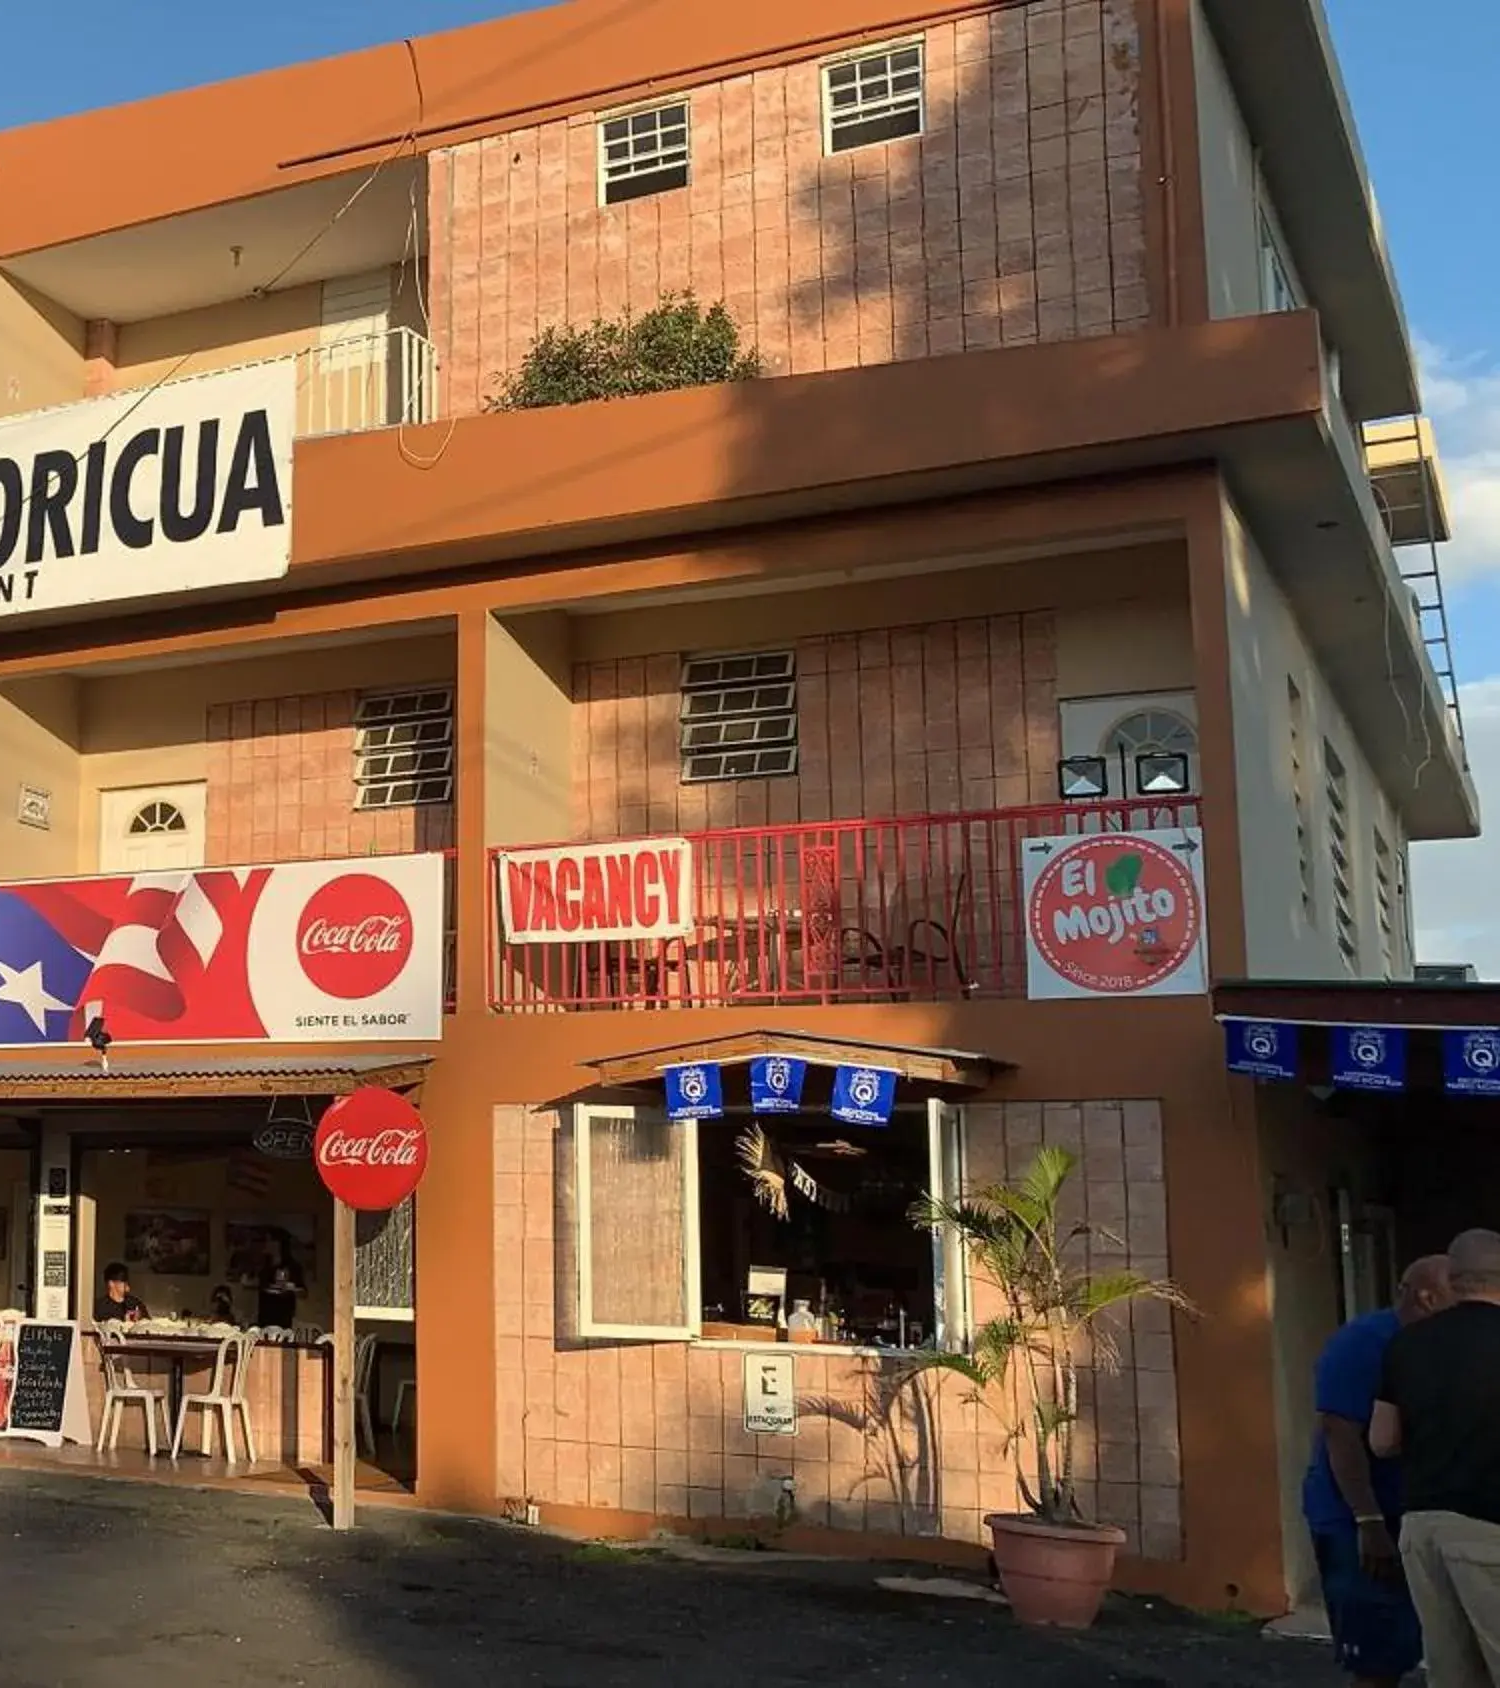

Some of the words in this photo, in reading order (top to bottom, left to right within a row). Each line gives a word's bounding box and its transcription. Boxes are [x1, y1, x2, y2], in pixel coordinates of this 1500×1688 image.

[508, 849, 682, 933] VACANCY
[1061, 858, 1096, 897] El
[301, 914, 407, 955] Coca-Cola
[1053, 886, 1176, 945] Mojito
[295, 1014, 339, 1027] SIENTE
[343, 1014, 358, 1026] EL
[361, 1013, 407, 1025] SABOR
[258, 1129, 314, 1151] OPEN
[319, 1129, 424, 1166] Coca-Cola
